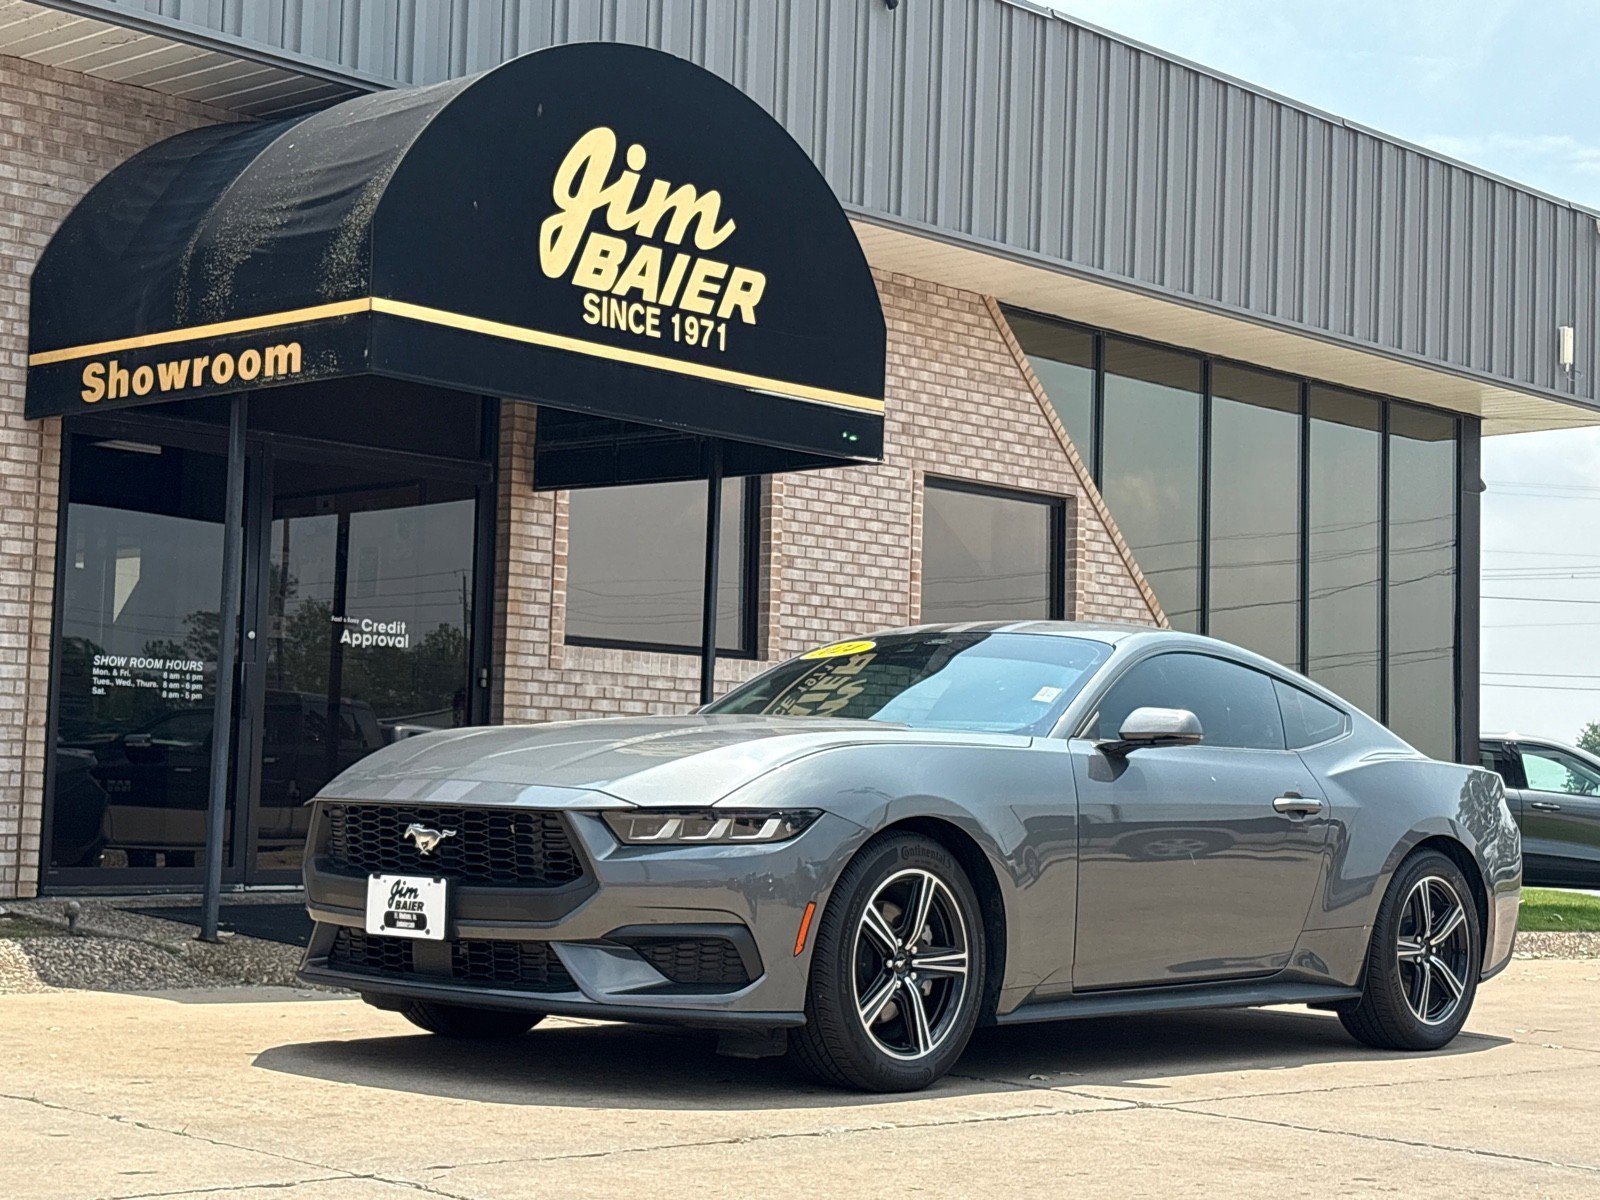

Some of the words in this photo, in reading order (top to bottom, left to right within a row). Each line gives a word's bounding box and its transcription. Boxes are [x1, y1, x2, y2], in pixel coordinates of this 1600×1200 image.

[539, 126, 736, 278] Jim
[571, 231, 766, 325] BAIER
[582, 293, 662, 338] SINCE
[671, 313, 726, 352] 1971
[81, 342, 302, 403] Showroom
[362, 618, 406, 634] Credit
[340, 630, 409, 648] Approval
[93, 655, 127, 666] SHOW
[129, 657, 163, 669] ROOM
[165, 660, 203, 671] HOURS
[92, 667, 110, 676] Mon.
[112, 668, 118, 676] &
[120, 669, 131, 677] Fri.
[192, 674, 203, 682] pm
[136, 679, 158, 688] Thurs.
[92, 686, 106, 695] Sat.
[191, 693, 202, 701] pm
[900, 843, 946, 866] Continental
[388, 879, 419, 909] Jim
[394, 900, 424, 912] BAIER
